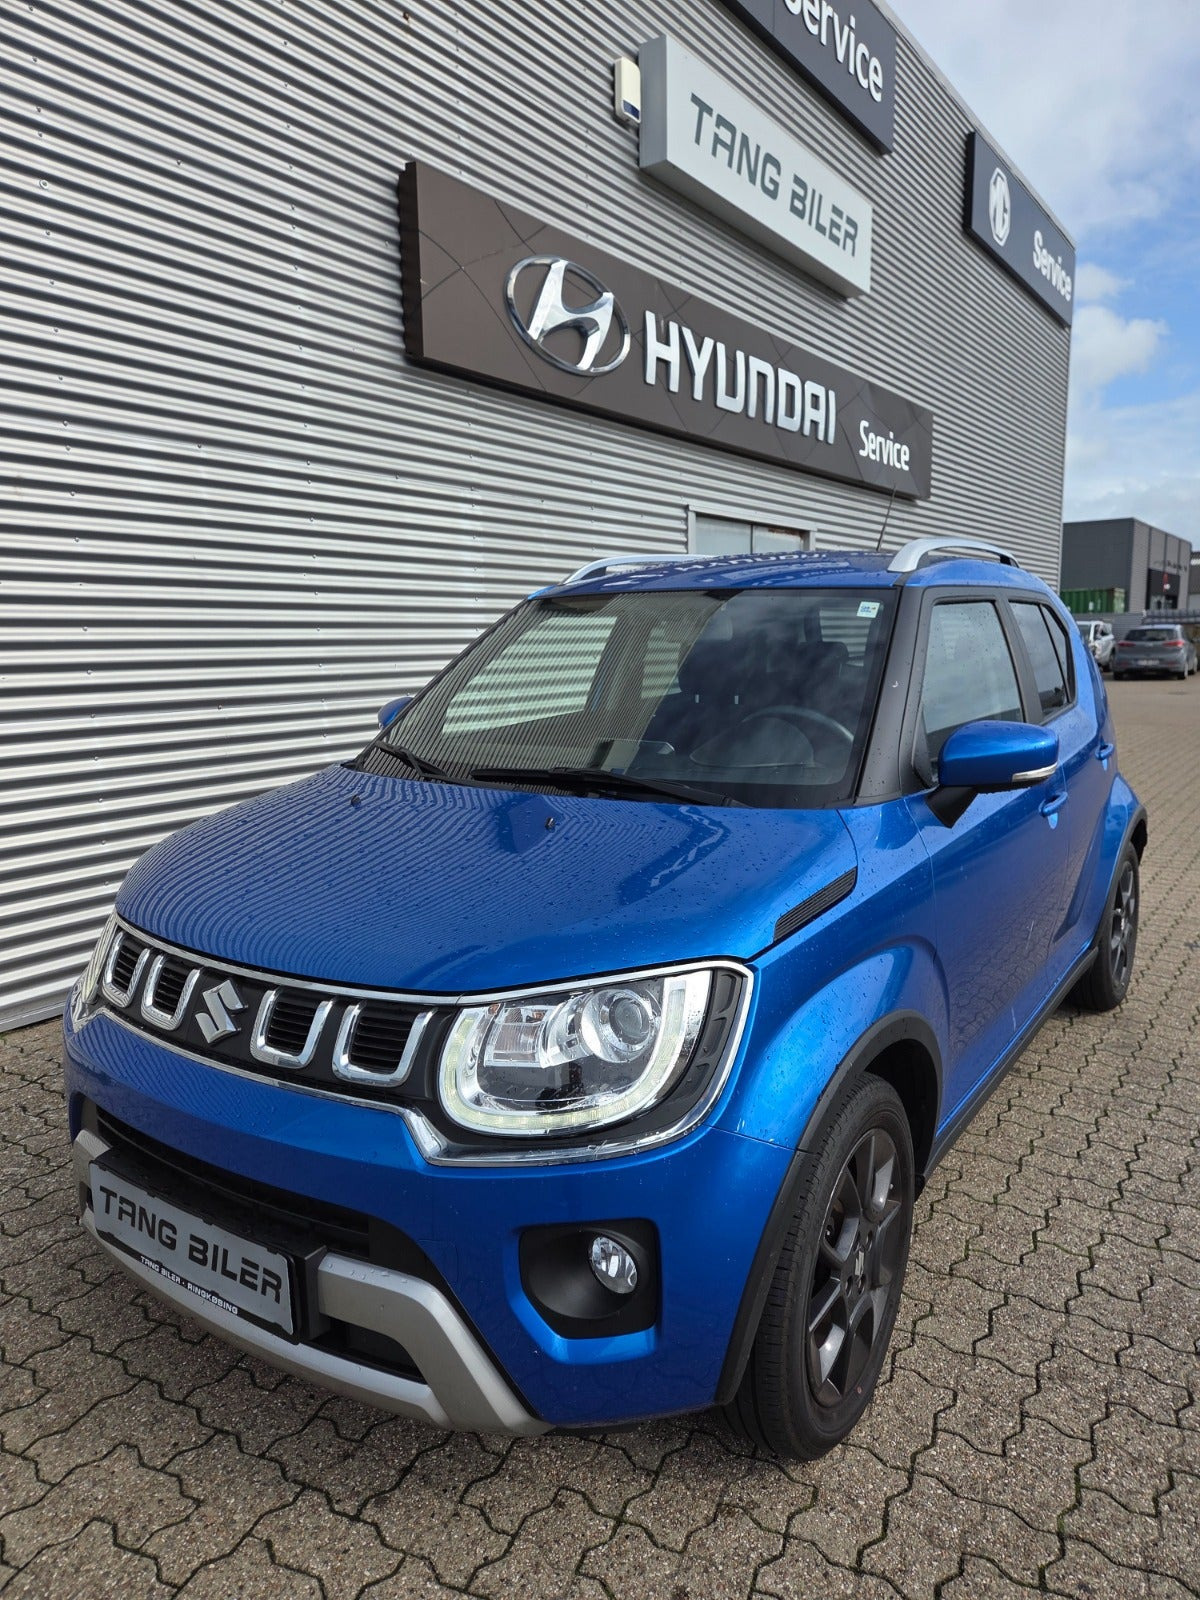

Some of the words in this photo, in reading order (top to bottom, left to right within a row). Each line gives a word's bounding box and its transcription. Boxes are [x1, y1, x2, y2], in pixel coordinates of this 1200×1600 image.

[784, 0, 883, 102] ervice
[690, 92, 782, 201] TANG
[789, 172, 859, 259] BILER
[1033, 230, 1072, 301] Service
[644, 310, 836, 445] HYUNDAI
[858, 419, 911, 472] Service
[100, 1186, 178, 1251] TANG
[188, 1233, 283, 1305] BILER
[140, 1255, 160, 1273] TANG
[161, 1267, 181, 1285] BILER
